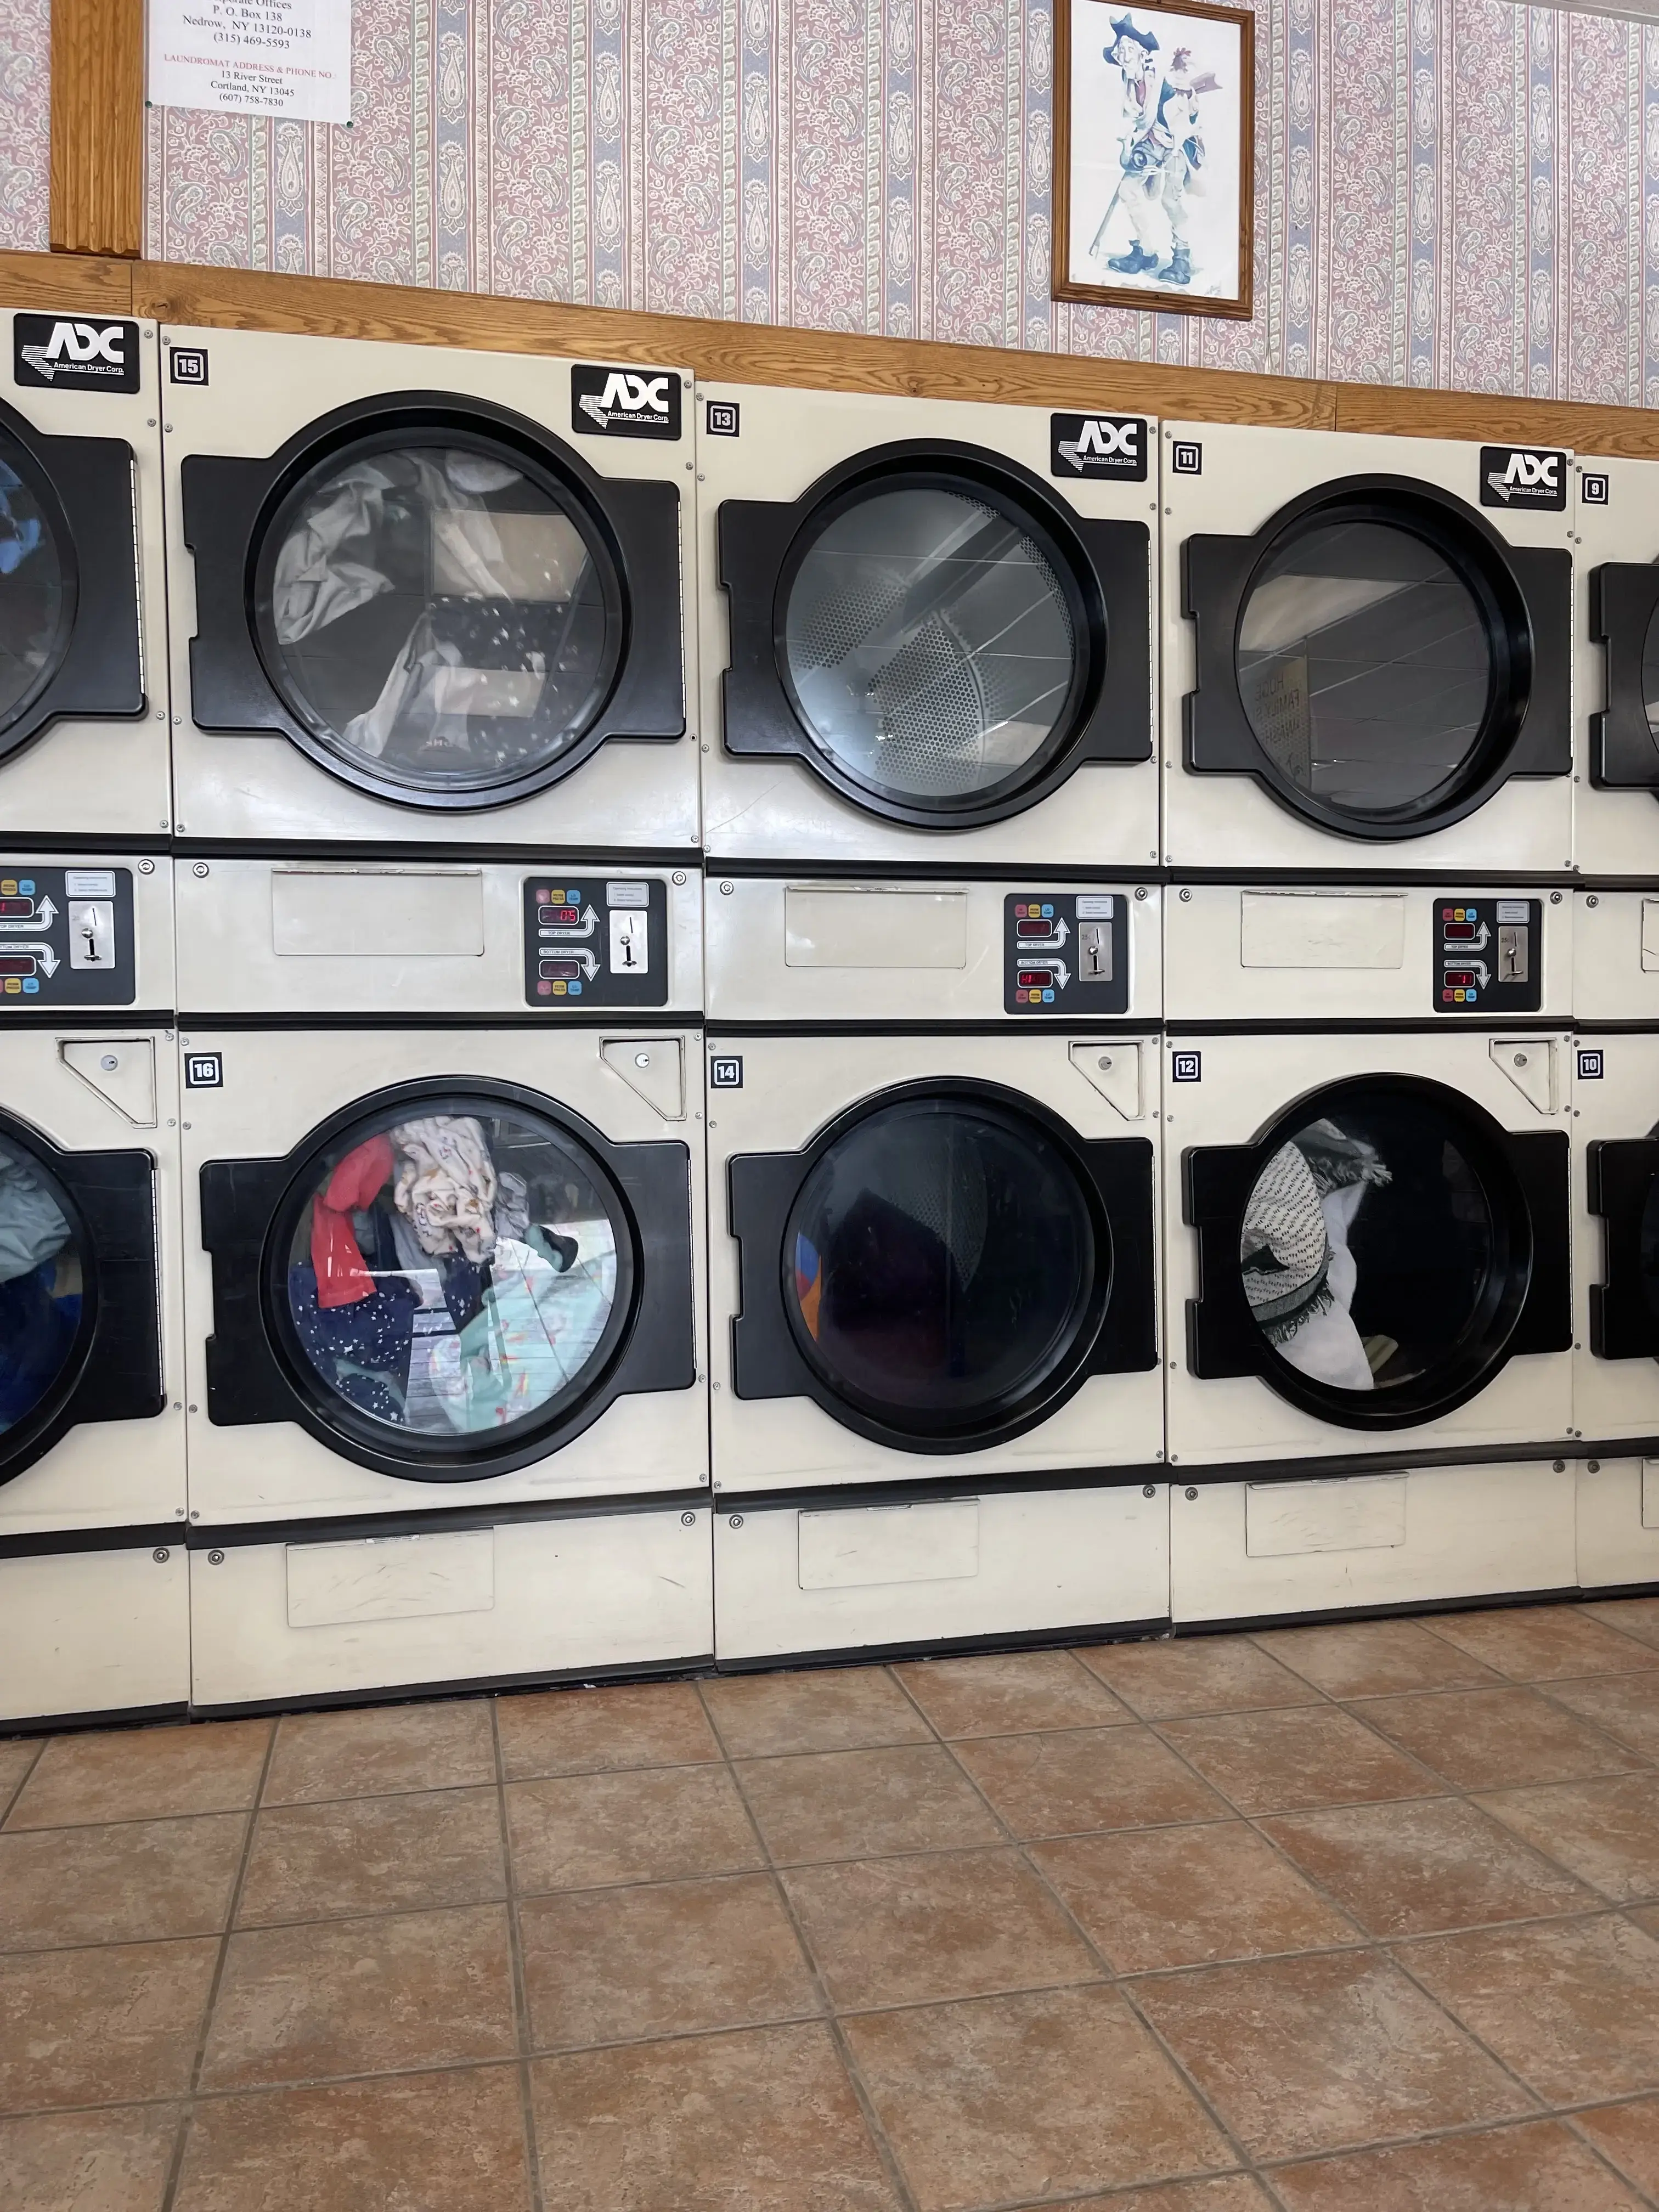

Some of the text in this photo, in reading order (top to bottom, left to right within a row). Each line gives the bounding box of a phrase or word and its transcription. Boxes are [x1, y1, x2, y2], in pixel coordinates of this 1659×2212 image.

[213, 4, 283, 21] P. O. Box 138
[183, 14, 311, 38] Nedrow, NY 13120-0138
[213, 32, 290, 49] (315) 469-5593
[164, 54, 230, 67] LAUNDROMAT
[233, 61, 274, 72] ADDRESS
[286, 67, 317, 77] PHONE
[222, 70, 283, 84] 13 River Street
[211, 80, 295, 97] Cortland, NY 13045
[219, 93, 284, 106] (607) 758-7830
[46, 321, 124, 364] ADC
[54, 362, 125, 374] American Dryer Corp.
[179, 359, 199, 374] 15
[600, 373, 669, 413] ADC
[607, 410, 636, 419] American
[636, 413, 653, 421] Dryer
[714, 412, 731, 426] 13
[1077, 420, 1137, 456] ADC
[1181, 451, 1193, 465] 11
[1504, 453, 1558, 487] ADC
[1592, 483, 1599, 495] 9
[194, 1063, 214, 1077] 16
[1179, 1060, 1194, 1073] 12
[1583, 1058, 1597, 1070] 10
[718, 1065, 735, 1079] 14
